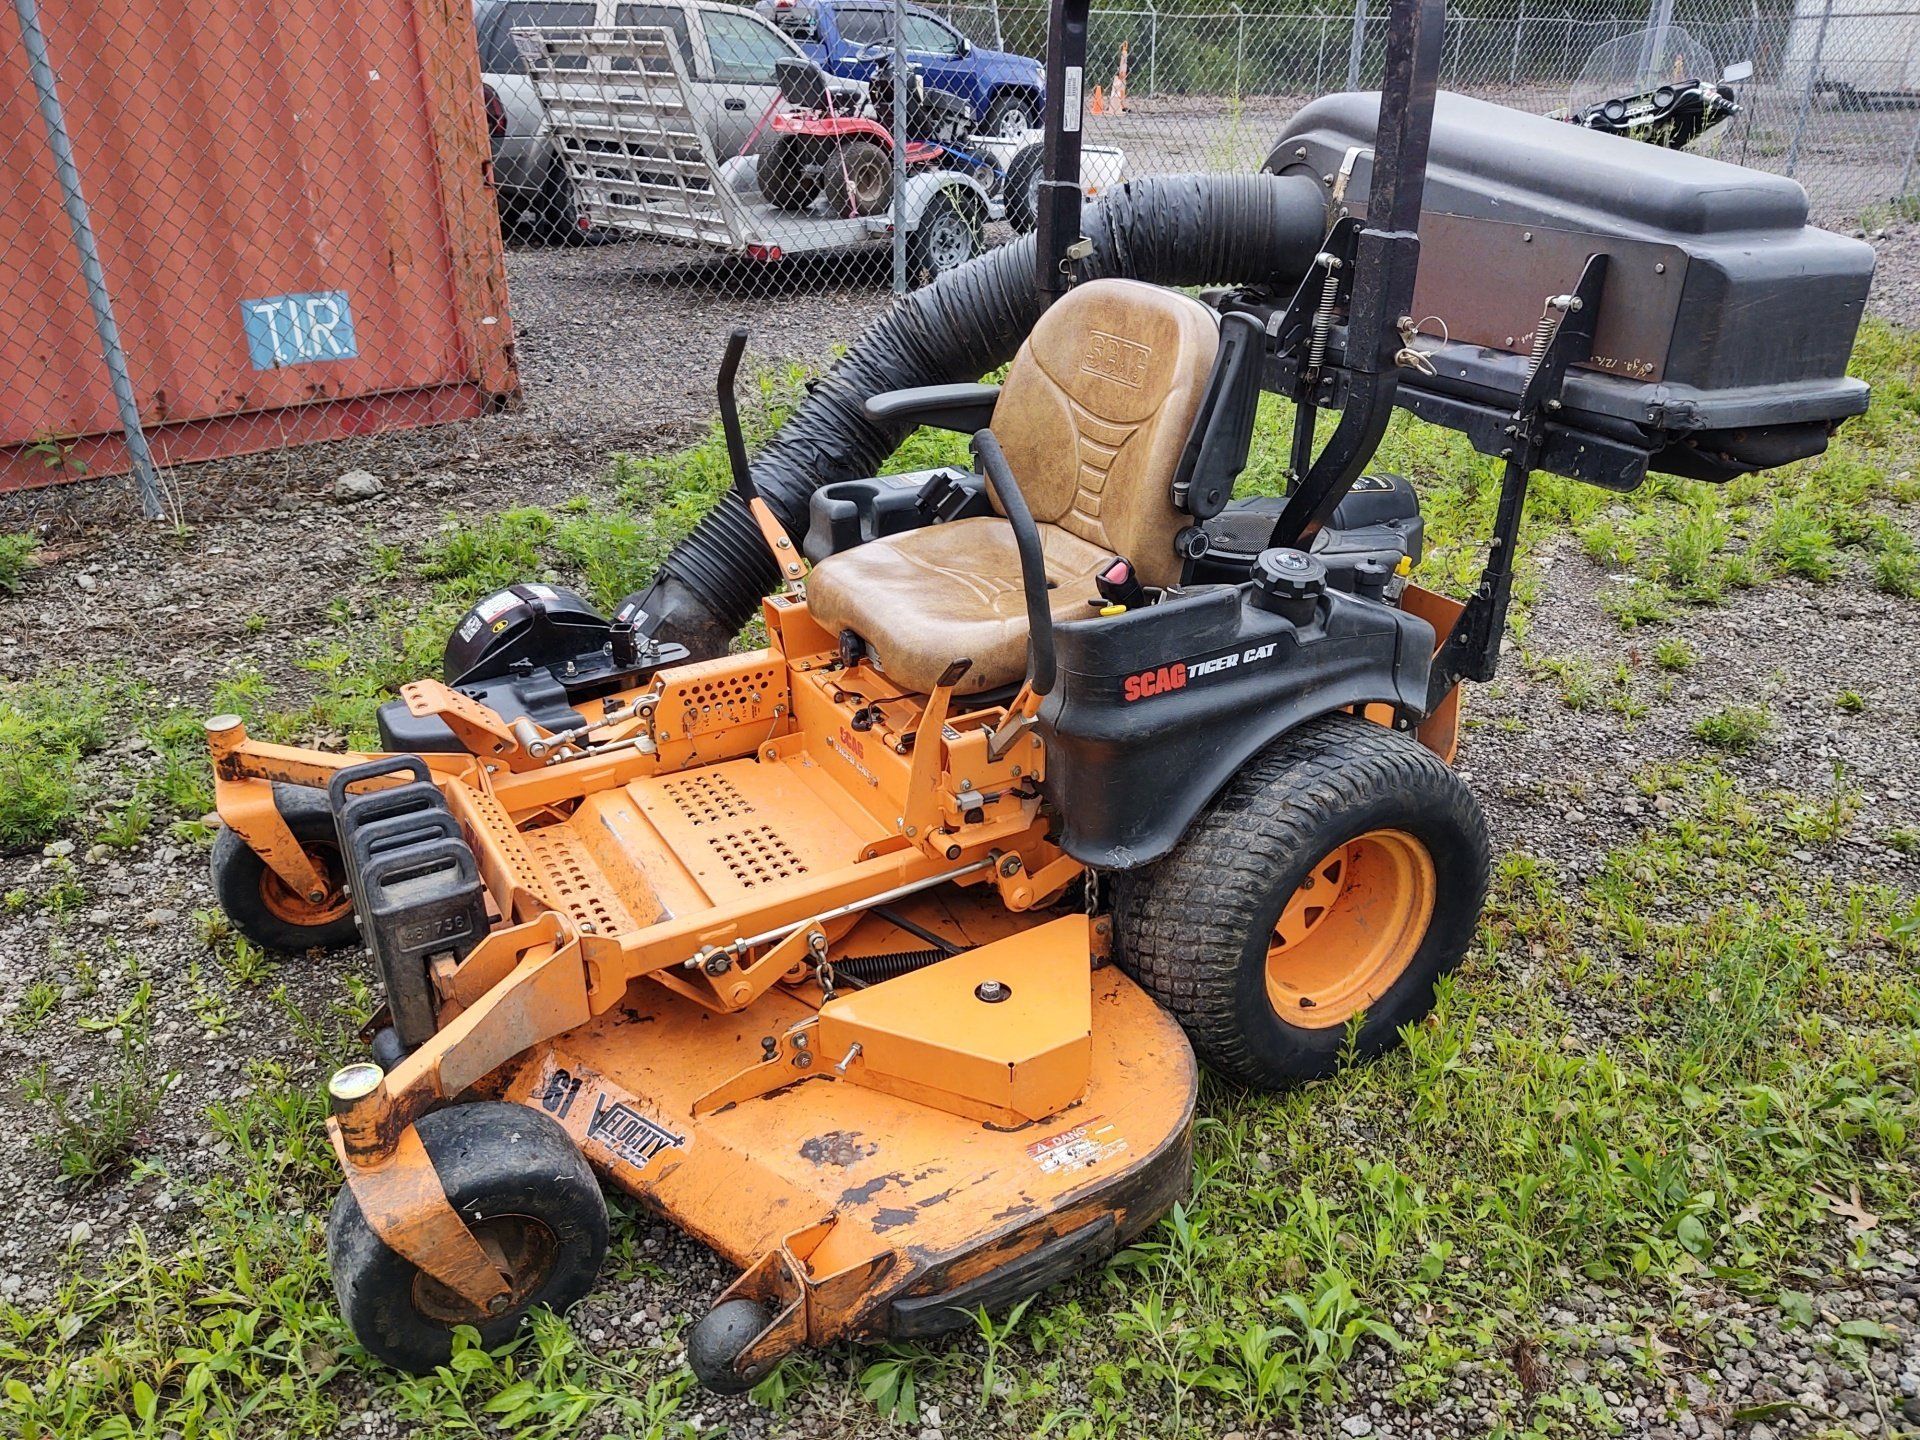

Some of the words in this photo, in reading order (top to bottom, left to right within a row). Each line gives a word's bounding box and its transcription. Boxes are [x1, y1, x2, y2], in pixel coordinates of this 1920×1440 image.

[1084, 334, 1148, 384] SCAG
[1124, 662, 1187, 702] SCAG
[1187, 653, 1240, 679] TIGER
[1242, 643, 1278, 664] CAT
[840, 726, 864, 760] SCAG
[1052, 1123, 1092, 1147] DANG
